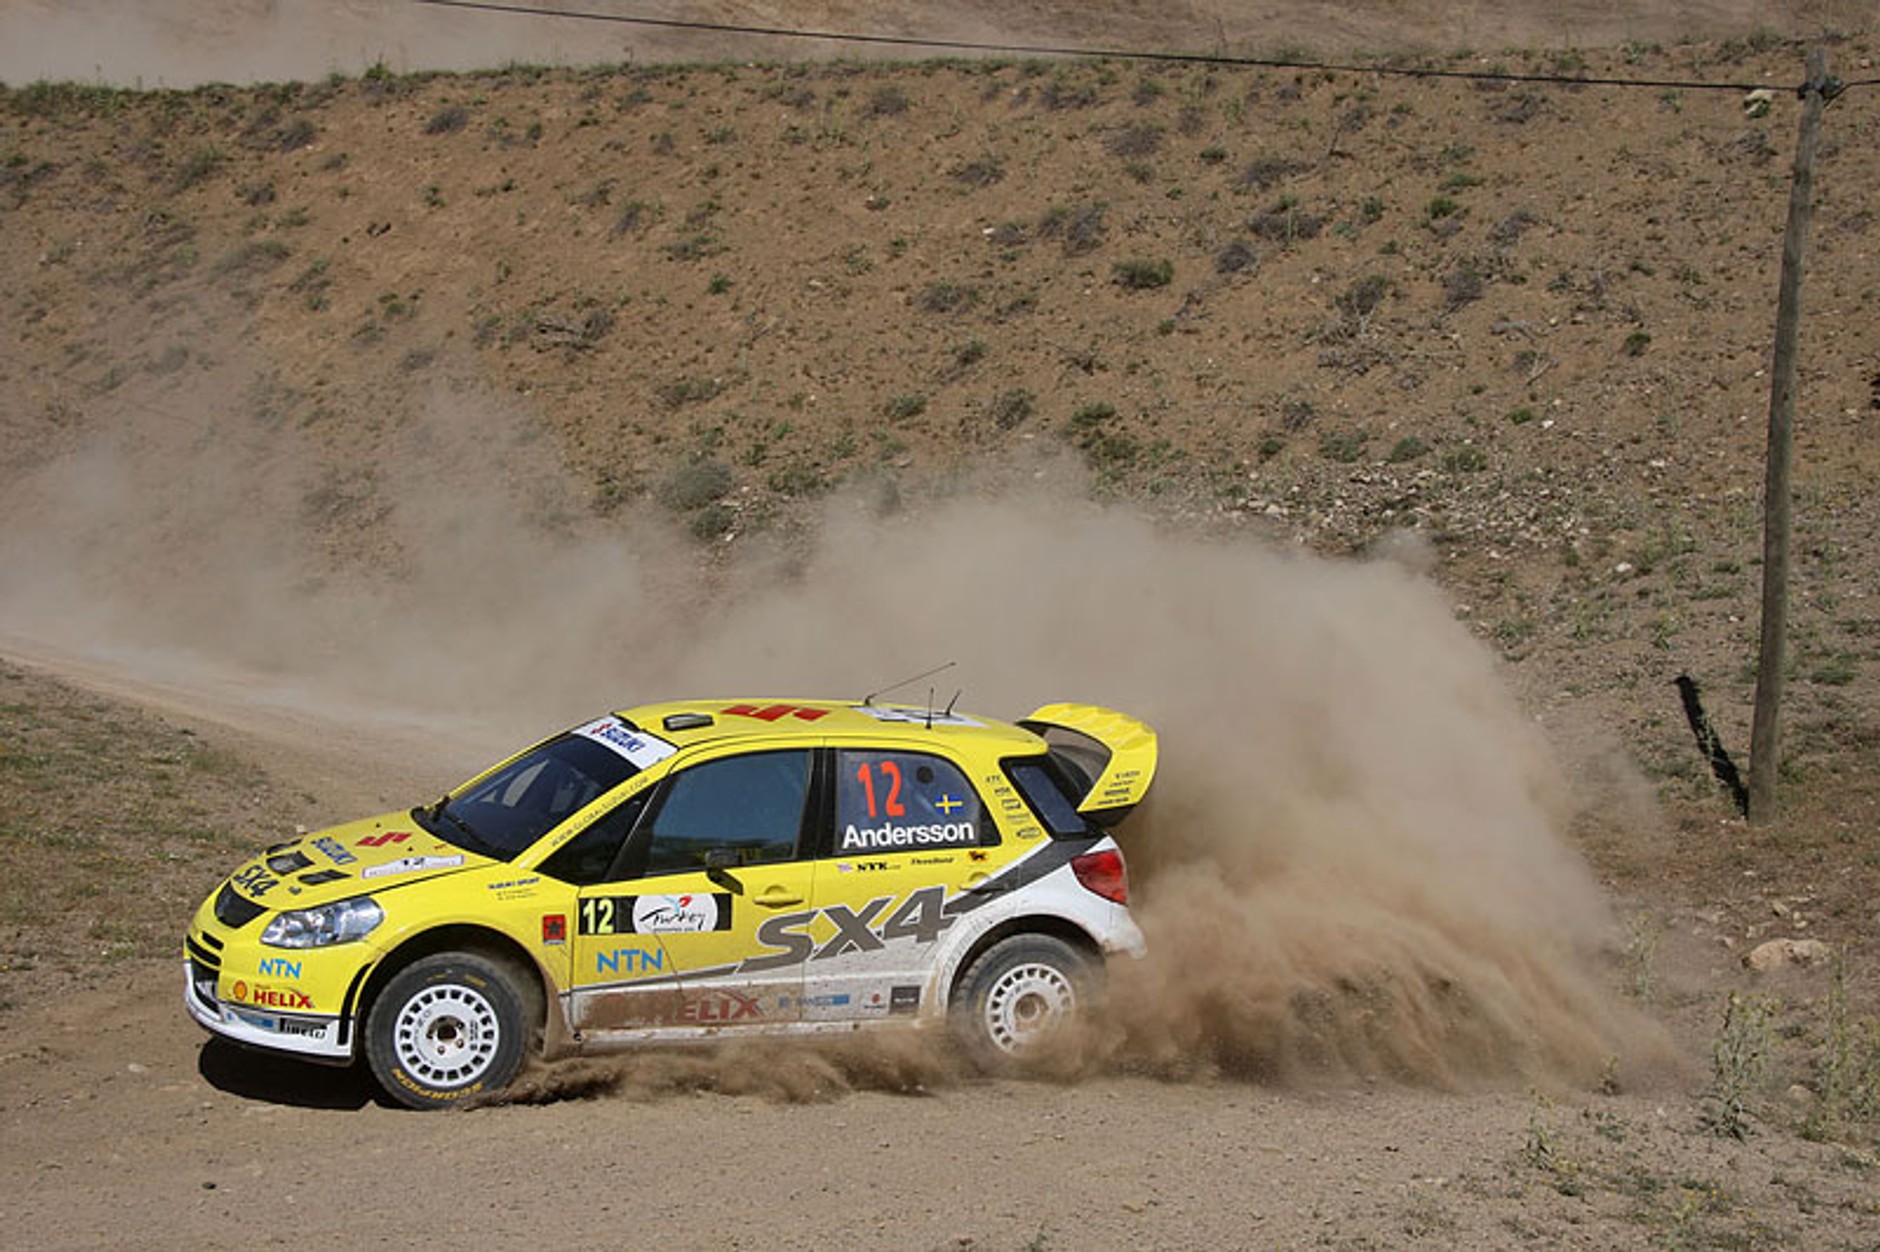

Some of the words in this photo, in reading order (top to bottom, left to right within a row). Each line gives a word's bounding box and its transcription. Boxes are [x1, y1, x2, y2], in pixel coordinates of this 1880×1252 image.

[857, 760, 906, 819] 12
[842, 821, 975, 849] Andersson
[232, 864, 280, 898] SX4
[583, 898, 615, 935] 12
[736, 884, 957, 974] SX4
[258, 957, 303, 980] NTN
[597, 948, 663, 973] NTN
[253, 987, 315, 1009] HELIX
